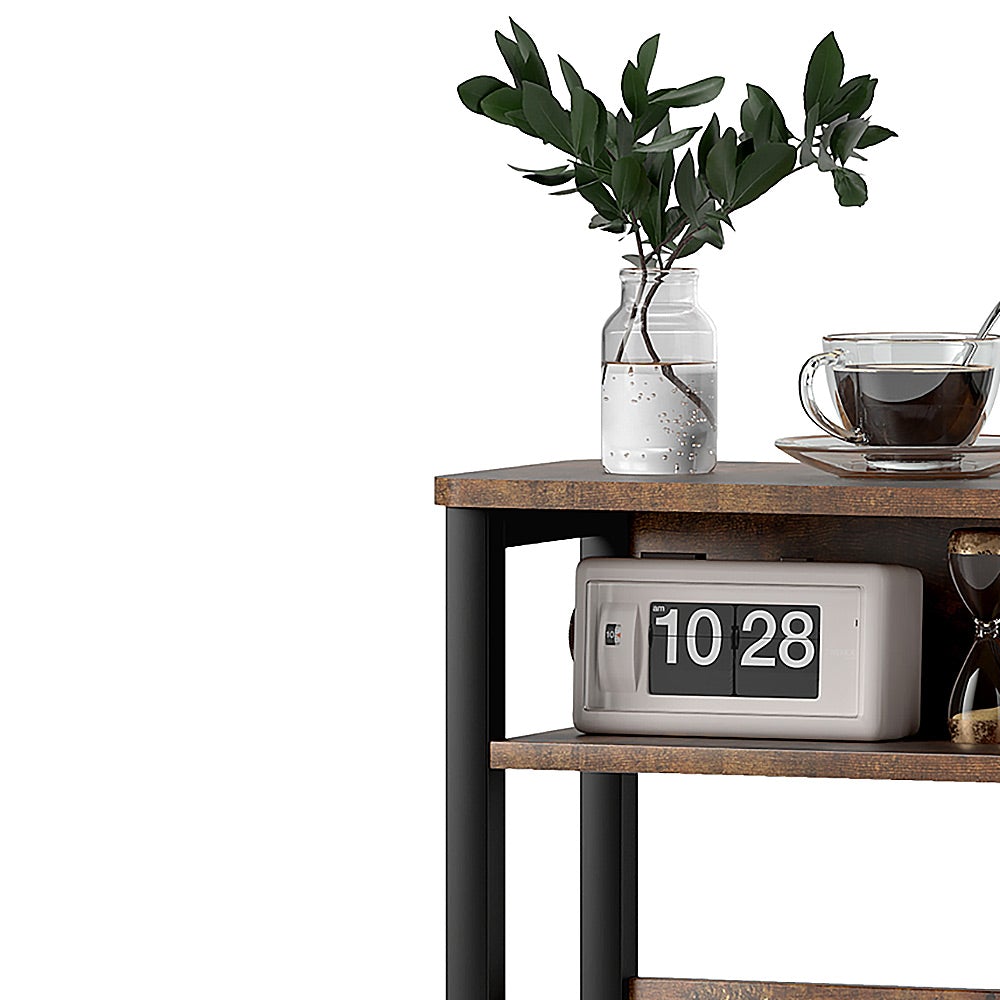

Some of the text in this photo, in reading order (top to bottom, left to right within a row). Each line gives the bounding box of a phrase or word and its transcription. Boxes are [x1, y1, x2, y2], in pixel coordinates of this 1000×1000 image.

[606, 630, 615, 639] 10
[655, 608, 816, 669] 10 28
